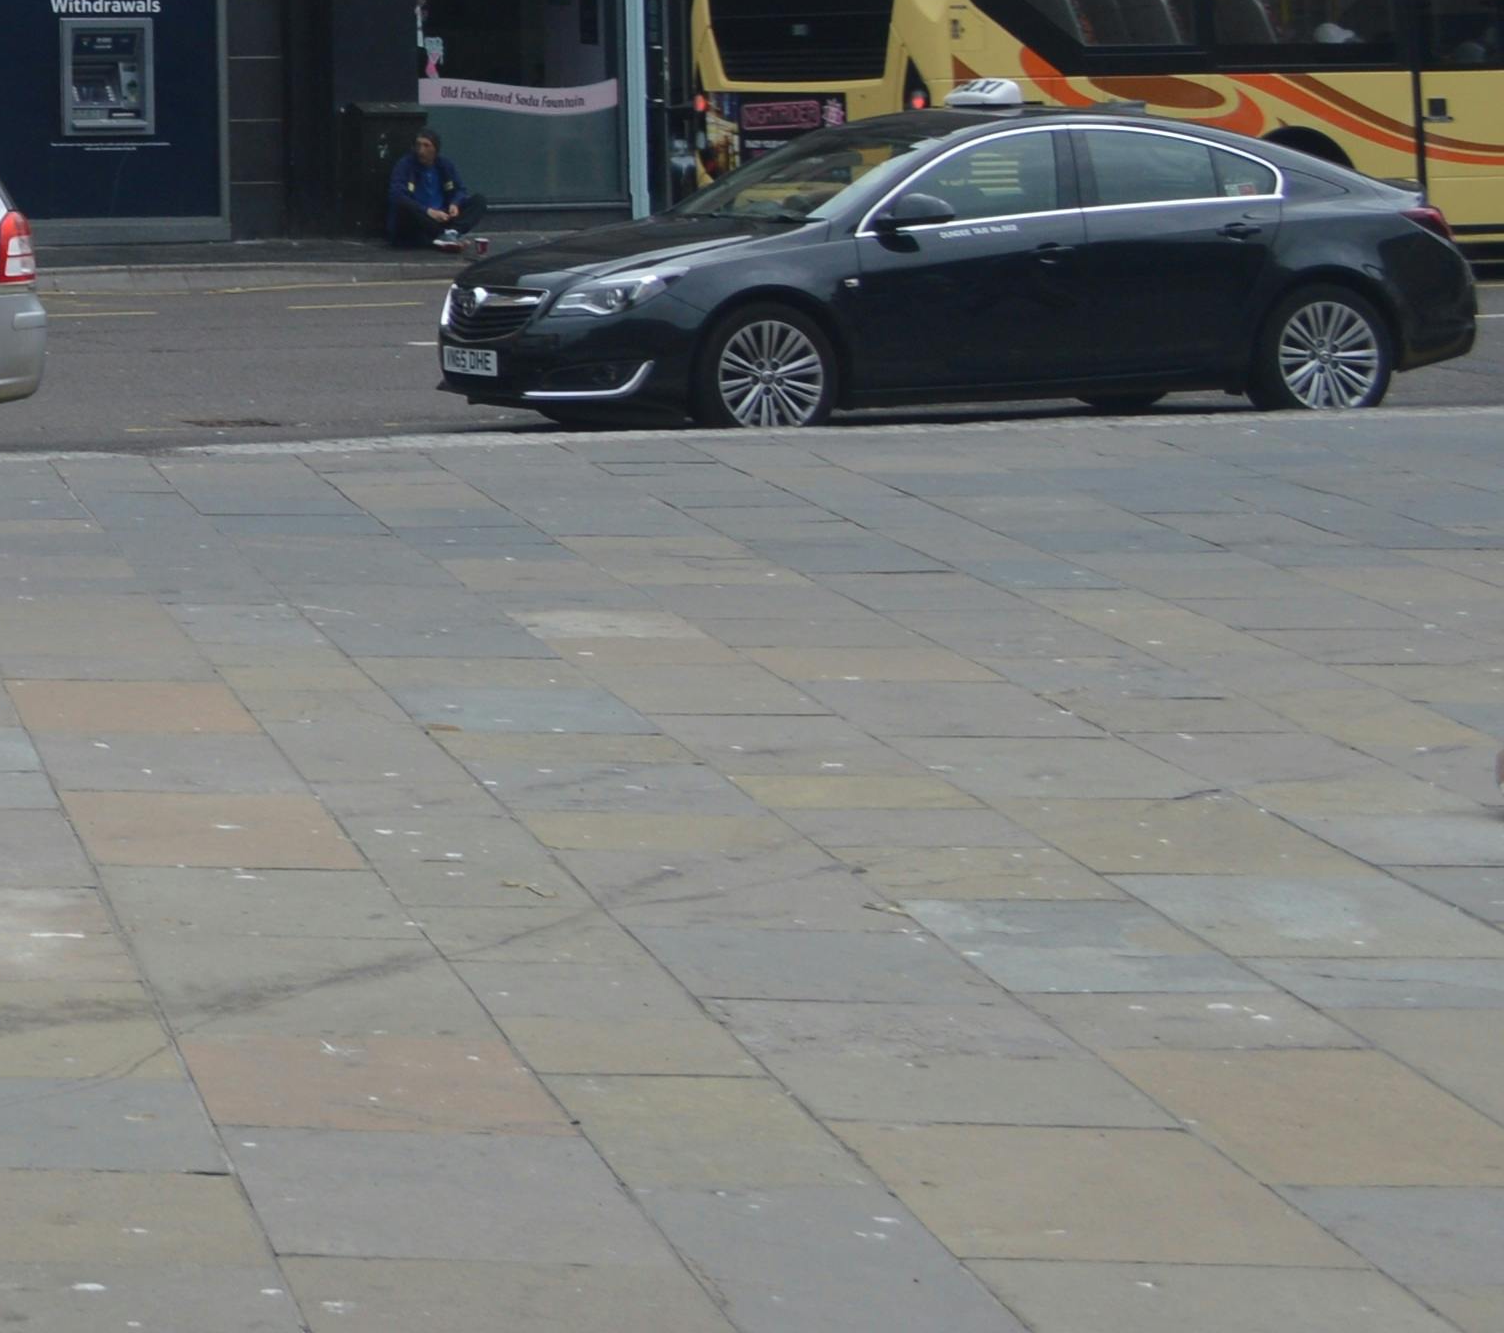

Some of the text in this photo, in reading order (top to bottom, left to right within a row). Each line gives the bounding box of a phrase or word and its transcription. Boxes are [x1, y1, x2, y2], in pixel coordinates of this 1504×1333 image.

[441, 86, 585, 108] Old Fashioned Soda Fountain
